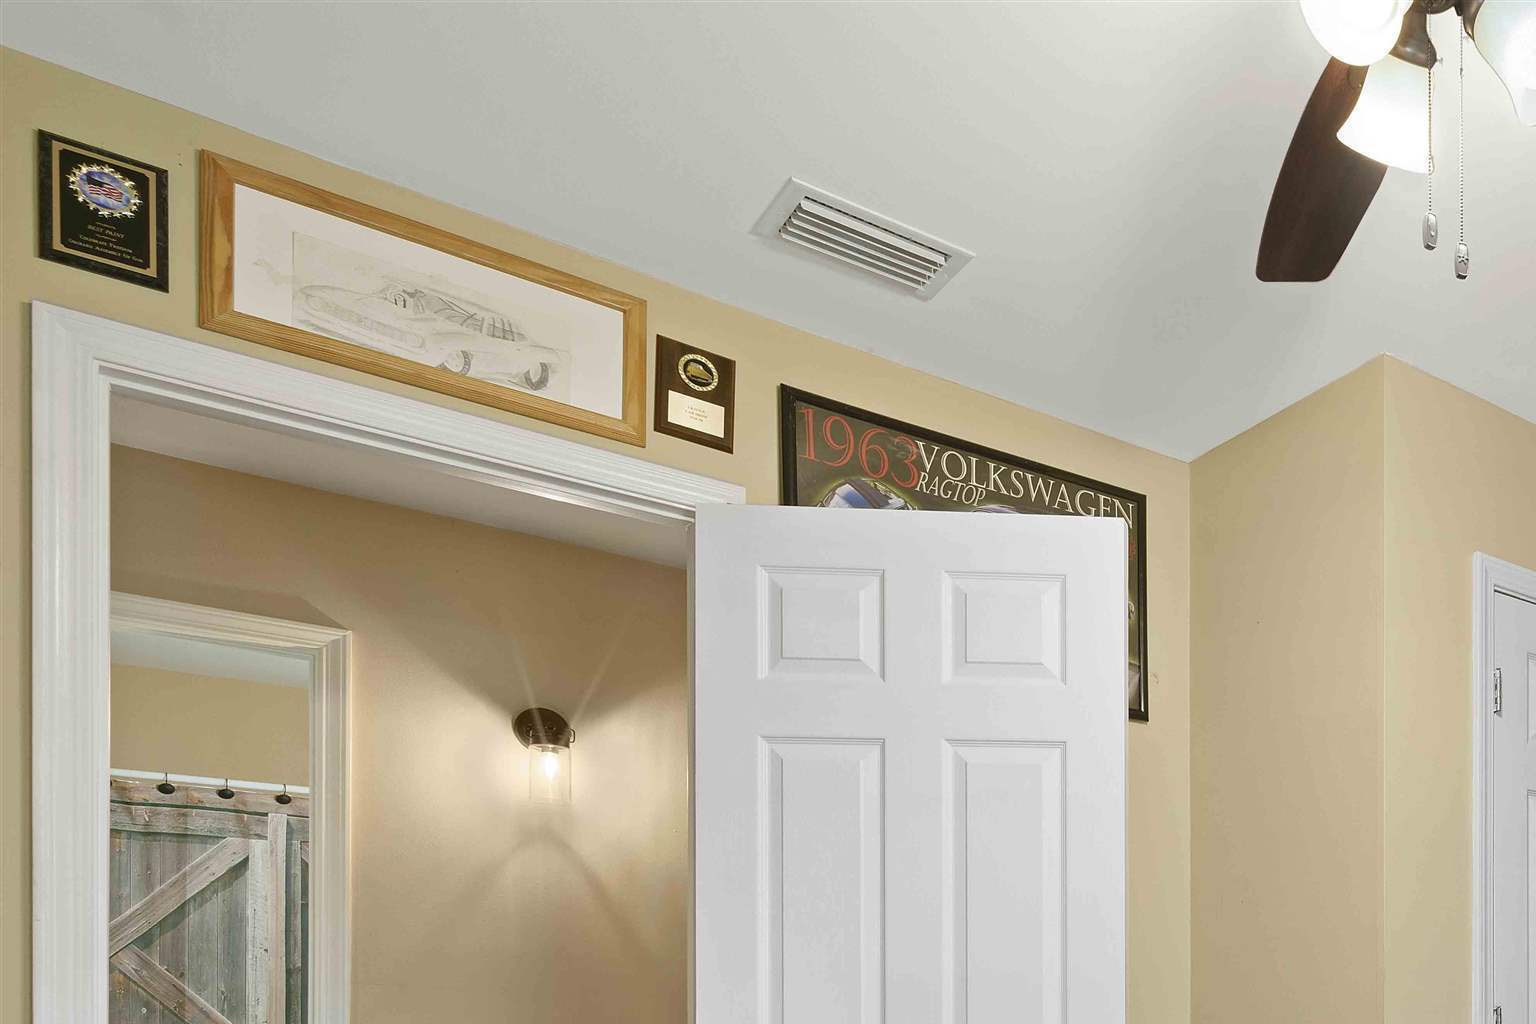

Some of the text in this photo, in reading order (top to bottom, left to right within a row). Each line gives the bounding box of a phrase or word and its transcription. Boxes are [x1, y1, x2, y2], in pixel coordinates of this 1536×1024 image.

[799, 406, 921, 489] 1963
[916, 440, 1135, 528] VOLKSWAGEN
[916, 471, 988, 507] RAGTOP
